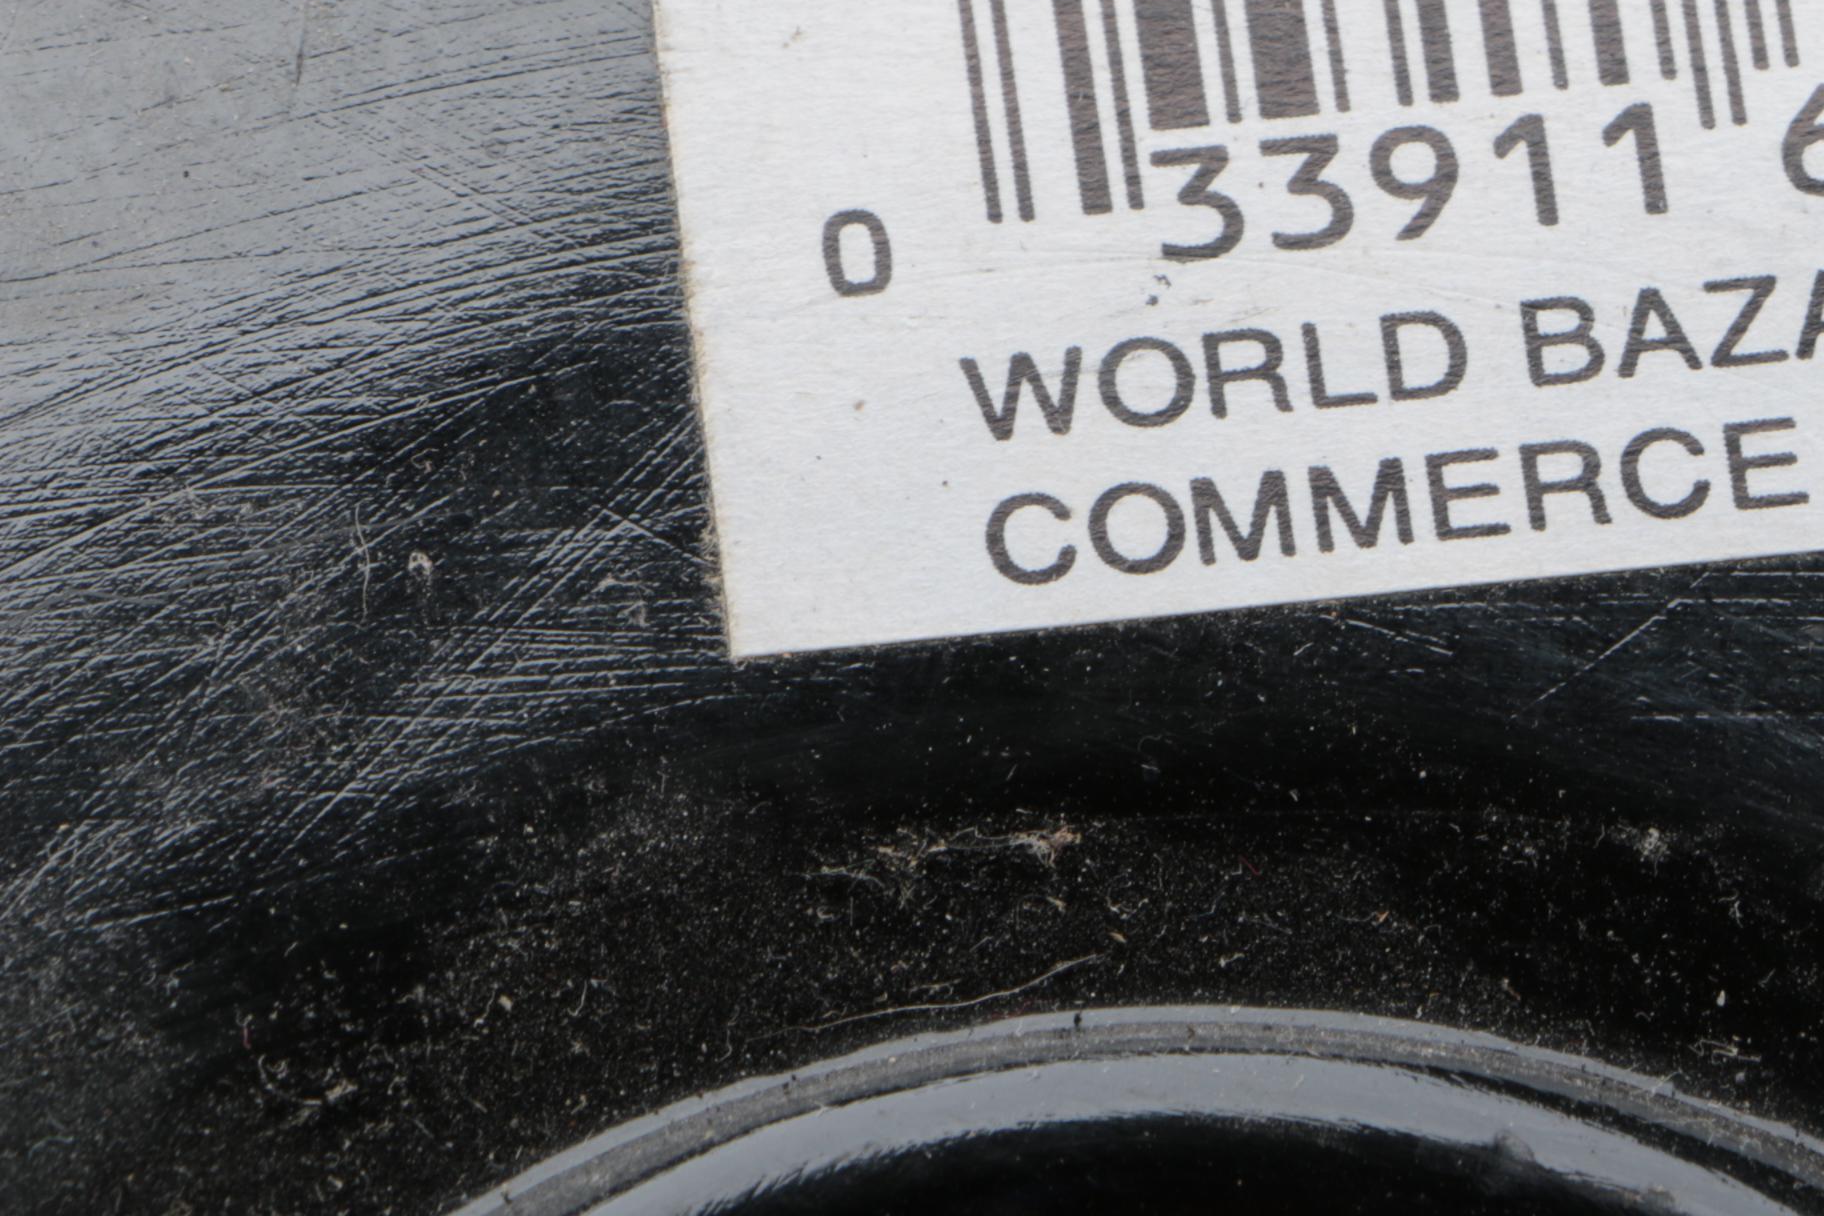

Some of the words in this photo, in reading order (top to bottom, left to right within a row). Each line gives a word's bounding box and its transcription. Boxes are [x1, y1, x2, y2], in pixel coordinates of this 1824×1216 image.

[822, 209, 892, 296] 0
[1150, 102, 1669, 262] 33911
[958, 309, 1468, 442] WORLD
[985, 416, 1810, 585] COMMERCE
